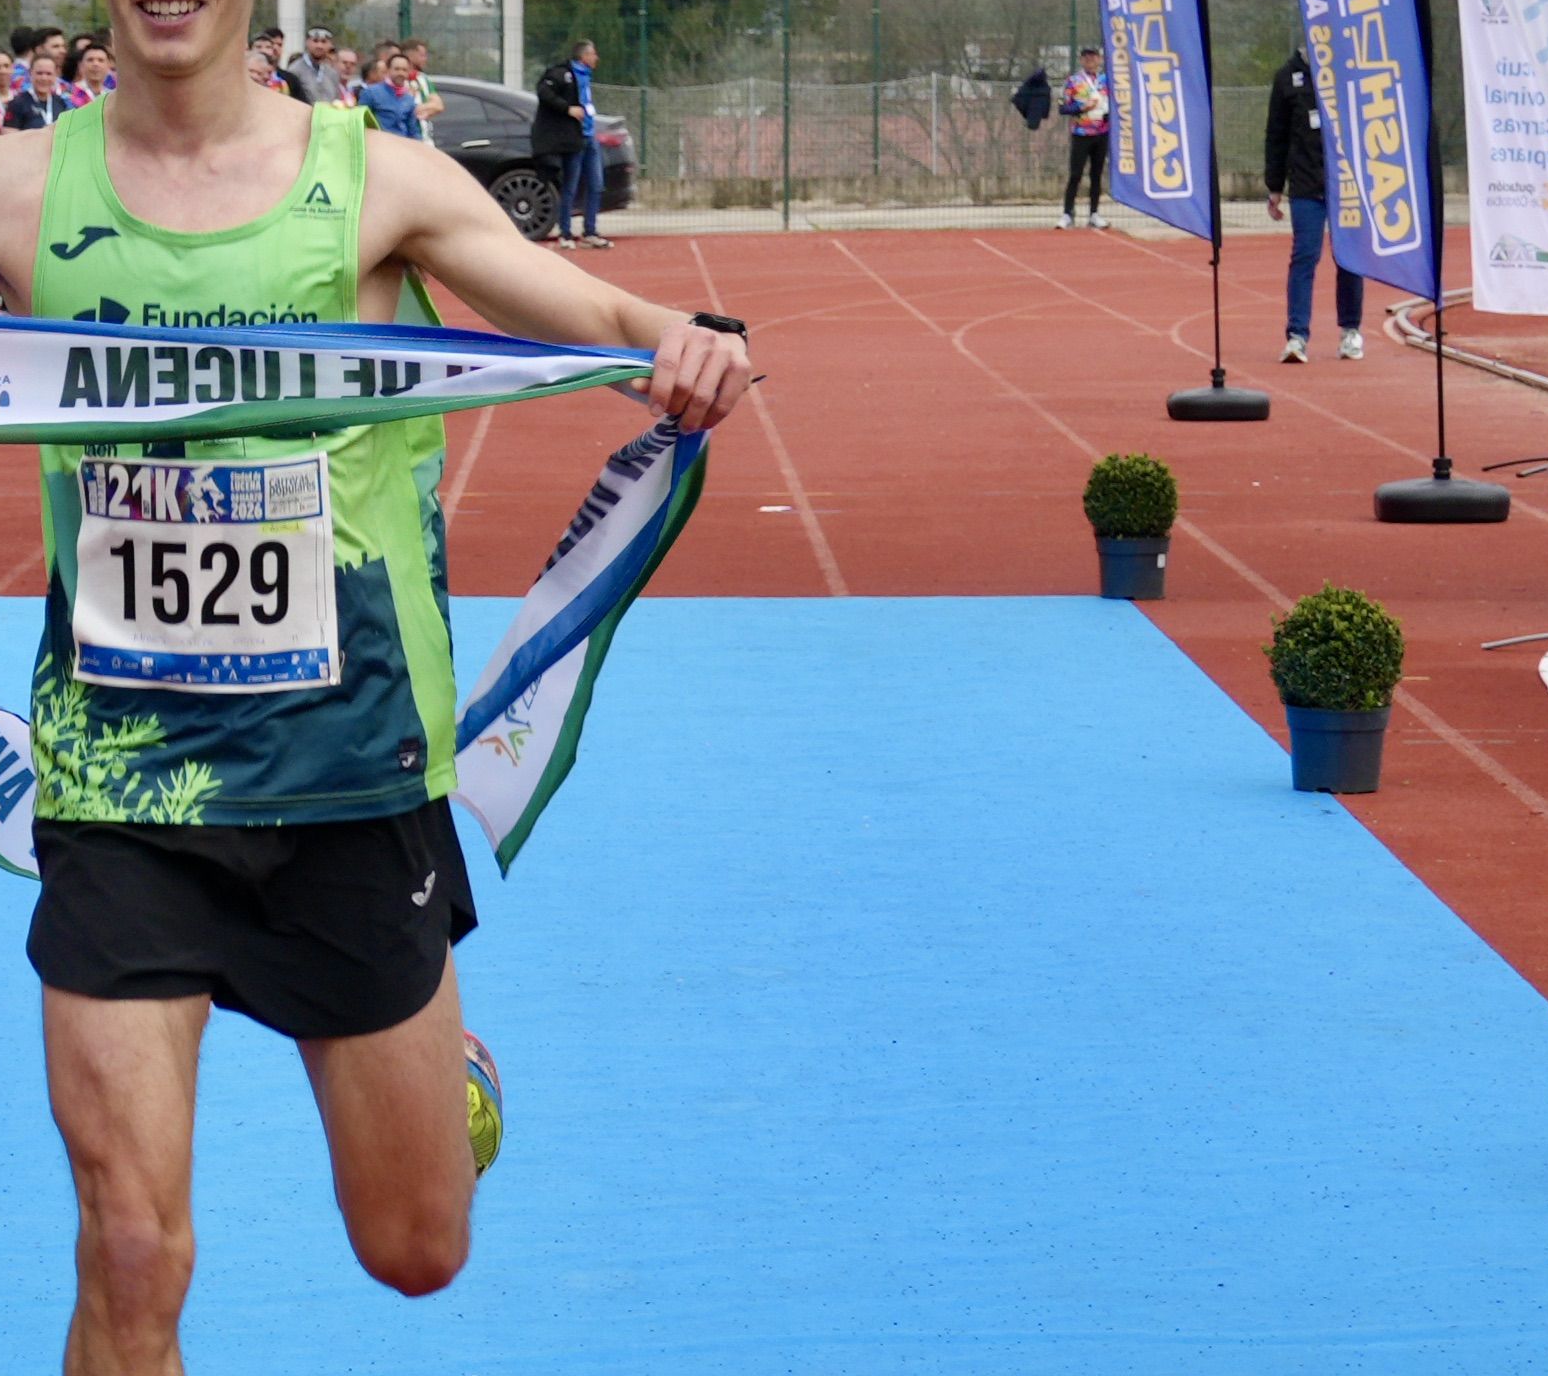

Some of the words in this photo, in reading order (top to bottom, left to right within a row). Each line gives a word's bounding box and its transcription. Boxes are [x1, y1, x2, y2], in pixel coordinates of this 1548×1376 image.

[142, 299, 318, 327] Fundación
[107, 463, 182, 522] 21K
[231, 503, 263, 521] 2026
[110, 538, 290, 626] 1529
